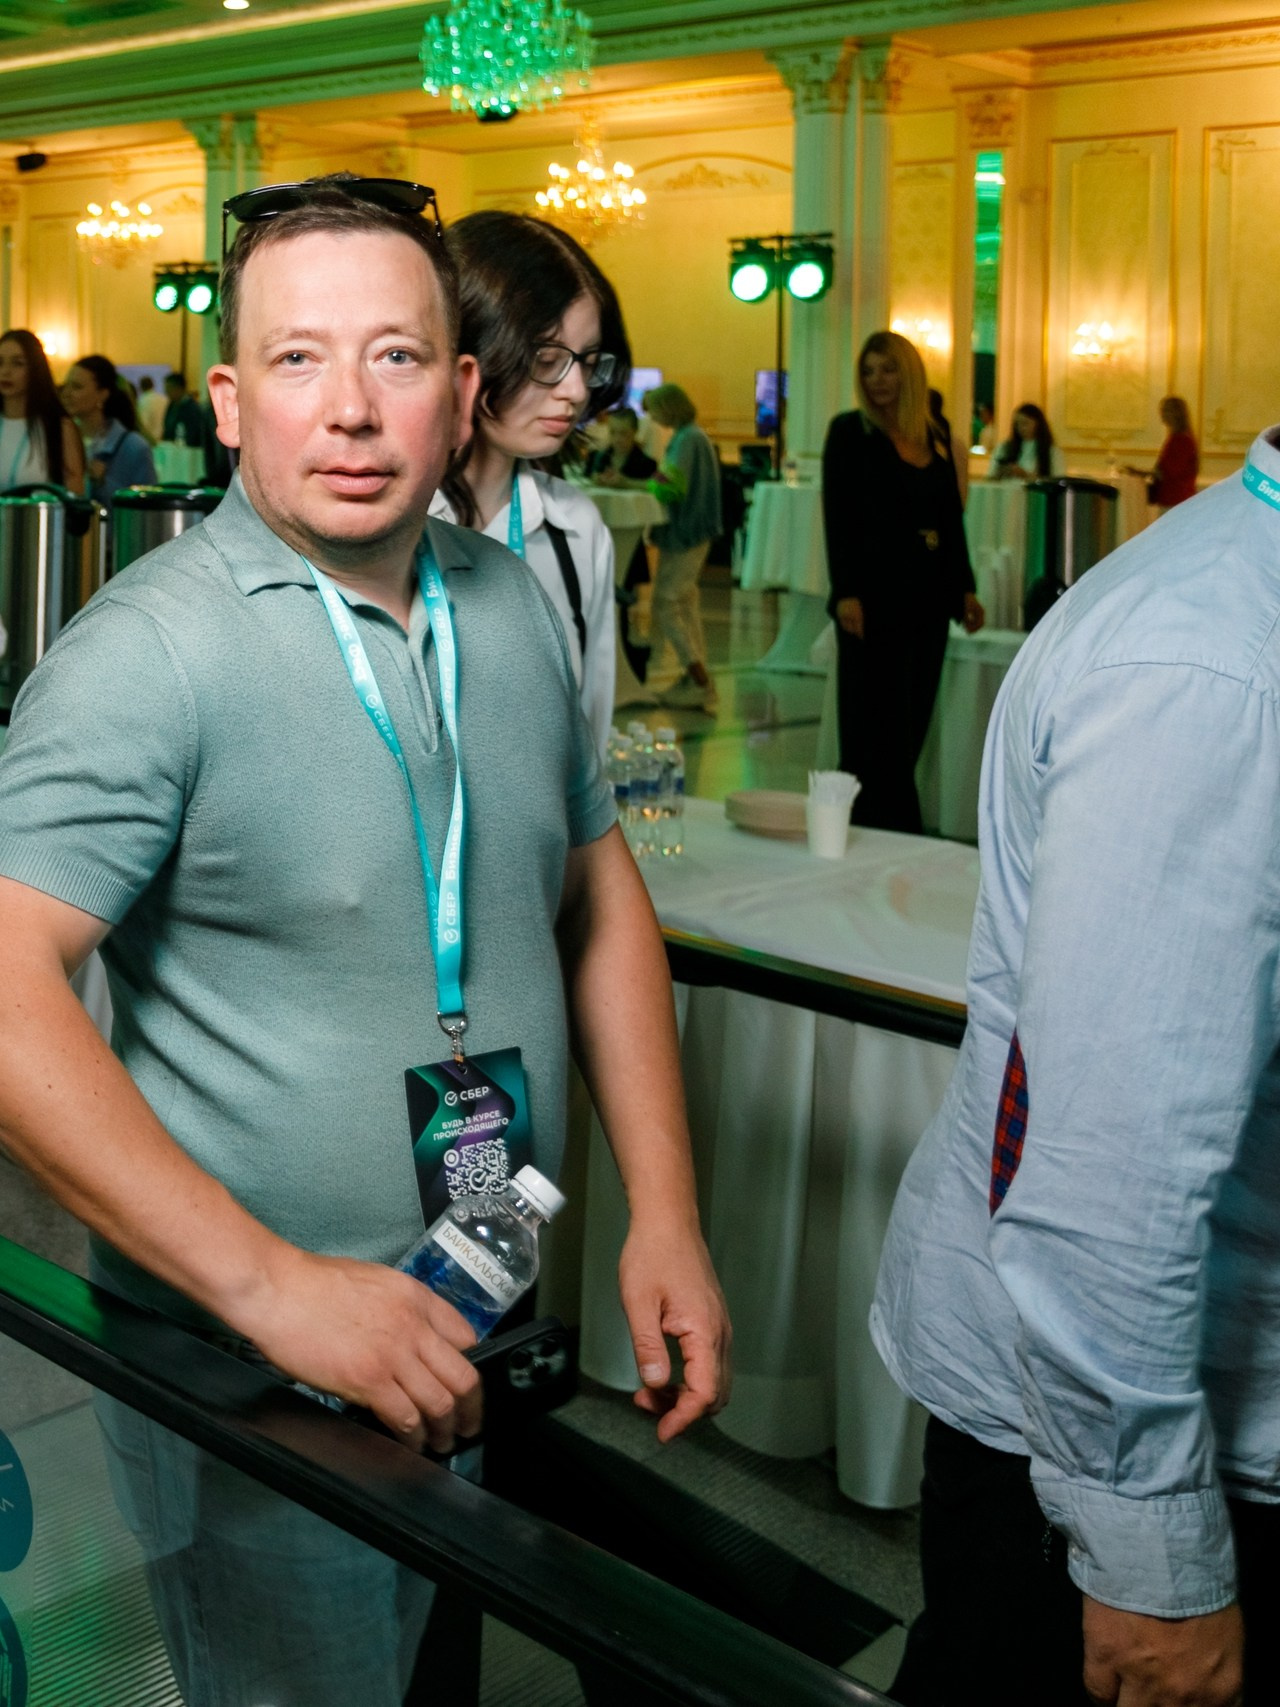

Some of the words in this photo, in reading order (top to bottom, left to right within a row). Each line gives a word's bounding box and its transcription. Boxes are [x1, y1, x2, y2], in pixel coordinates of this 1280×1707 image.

[374, 710, 394, 741] СБЕР
[445, 825, 459, 880] Бизнес
[444, 891, 456, 926] СБЕР
[459, 1086, 490, 1101] СБЕР
[432, 1117, 510, 1142] ПРОИСХОДЯЩЕГО
[441, 1116, 464, 1130] БУДЬ
[465, 1115, 472, 1124] В
[472, 1109, 501, 1123] КУРСЕ
